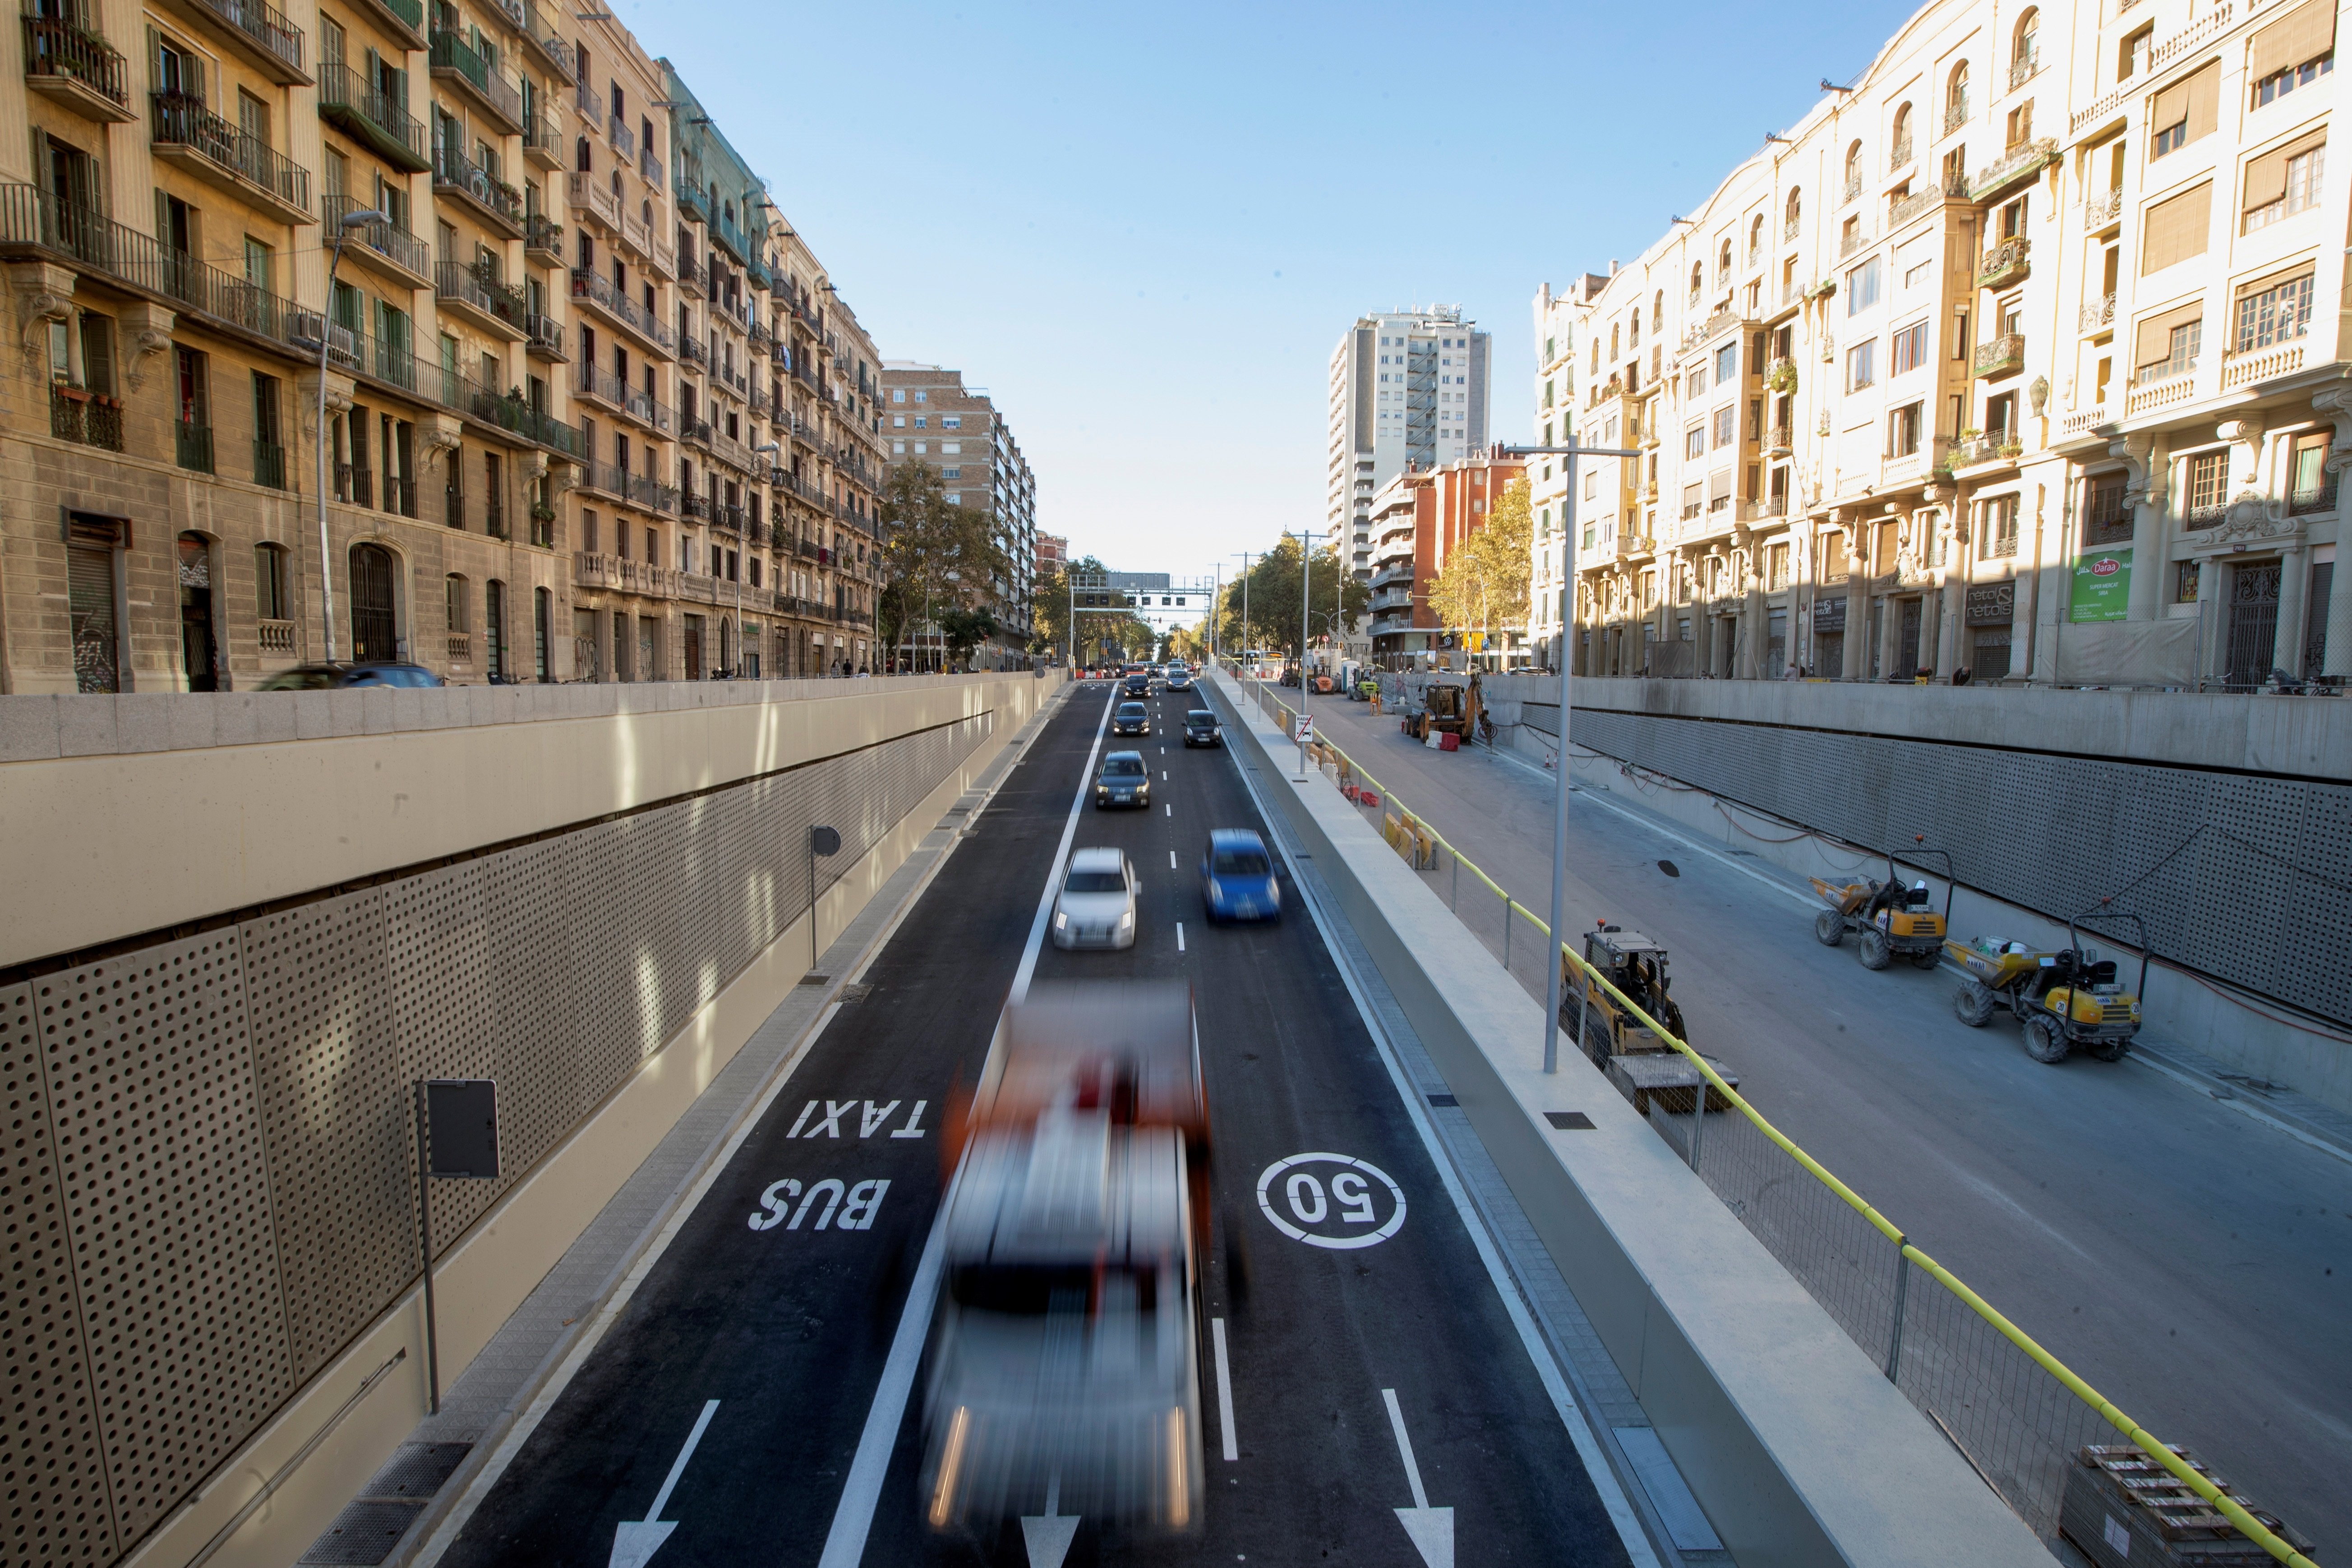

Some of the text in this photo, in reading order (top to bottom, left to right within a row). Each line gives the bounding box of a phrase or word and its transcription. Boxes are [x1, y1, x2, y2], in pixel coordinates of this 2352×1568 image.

[2094, 564, 2116, 573] Daraa
[1997, 586, 2012, 604] &
[2057, 1002, 2064, 1011] 20
[2133, 1004, 2140, 1013] 20
[786, 1100, 927, 1138] TAXI
[748, 1178, 892, 1231] BUS
[1287, 1172, 1375, 1223] 50
